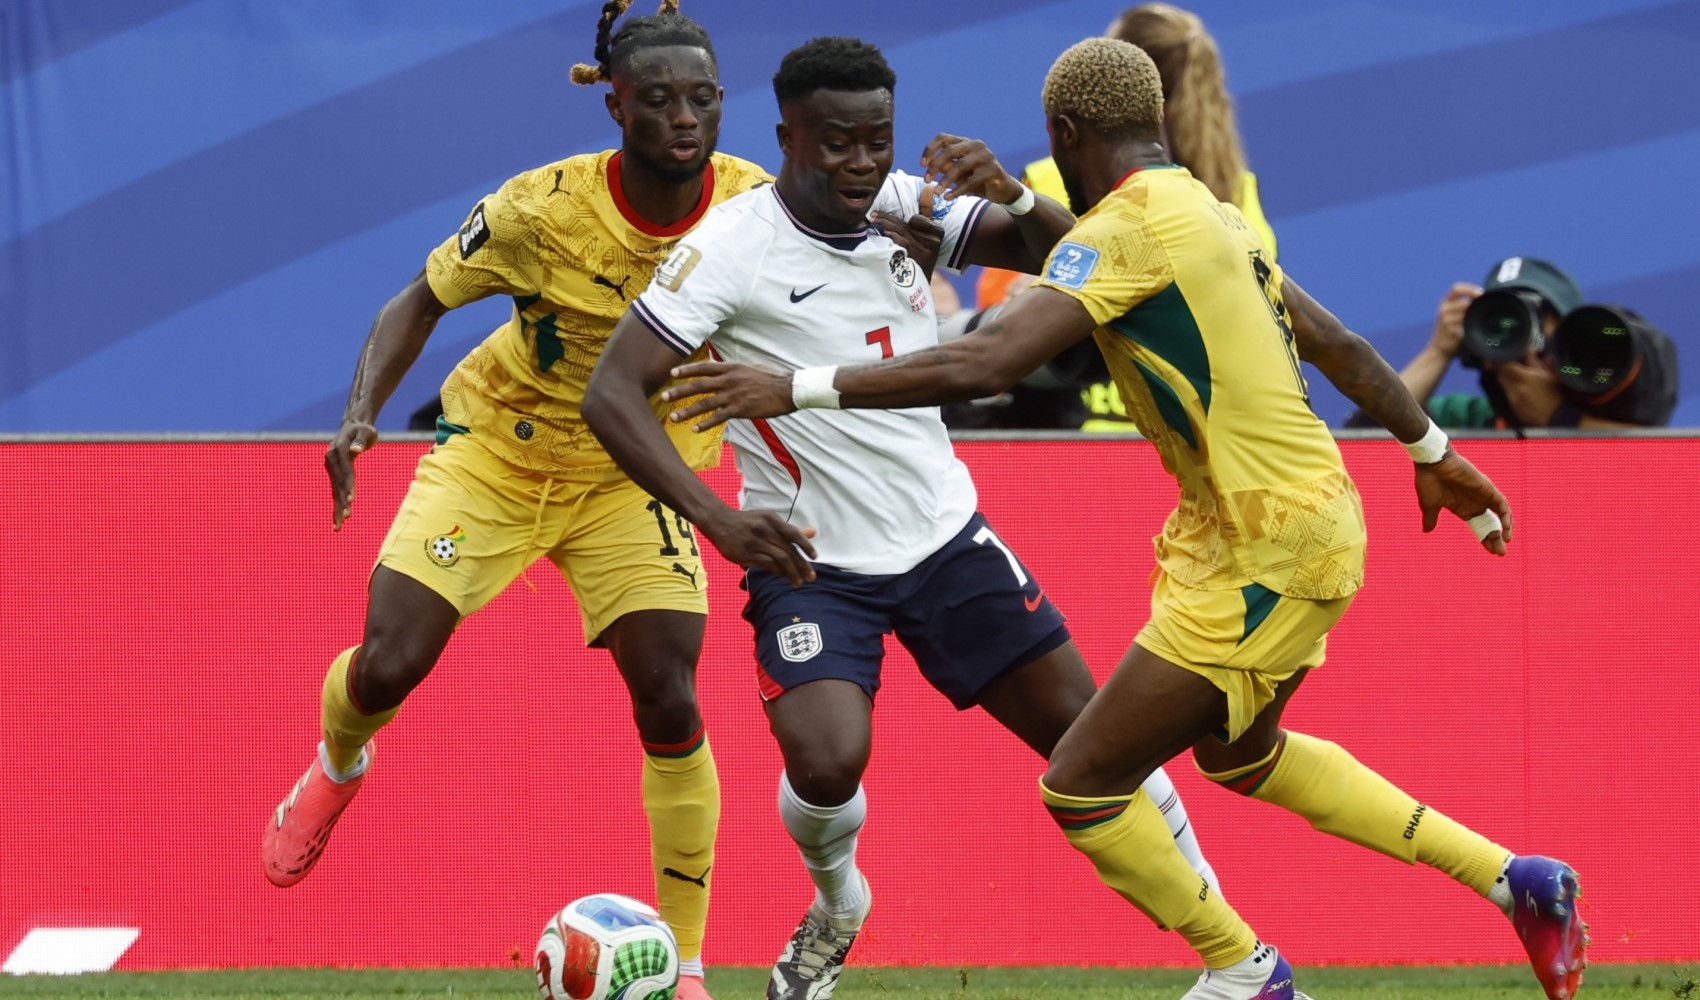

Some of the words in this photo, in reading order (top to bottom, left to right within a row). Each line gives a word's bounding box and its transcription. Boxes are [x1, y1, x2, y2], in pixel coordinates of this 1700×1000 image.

[865, 325, 894, 360] 7
[972, 526, 1028, 587] 7
[1403, 801, 1426, 840] GHAN
